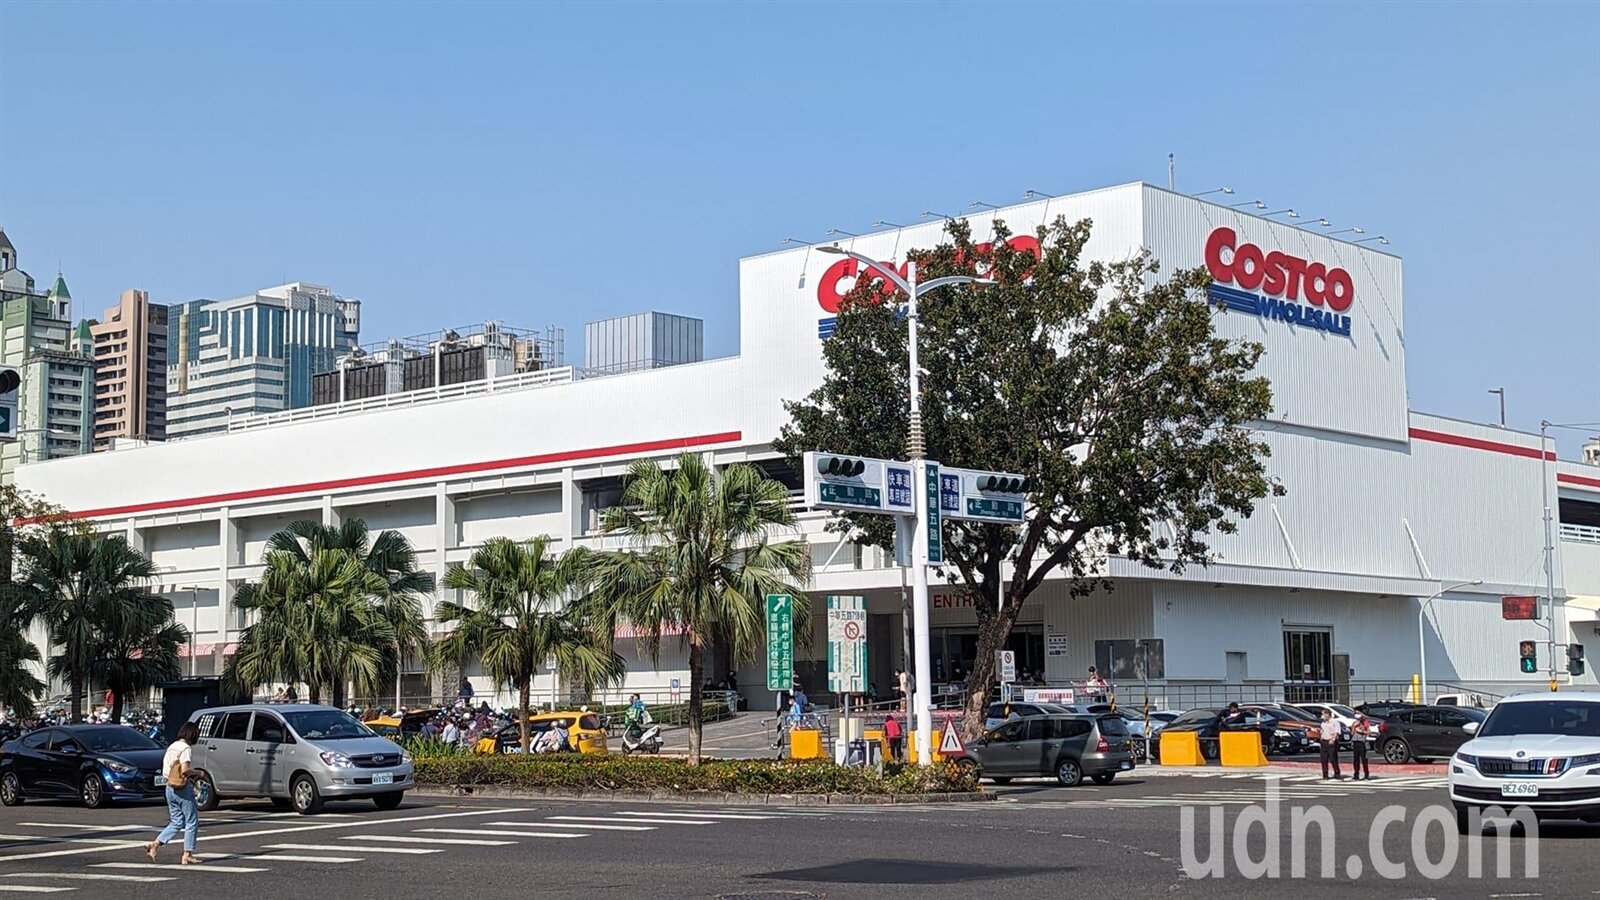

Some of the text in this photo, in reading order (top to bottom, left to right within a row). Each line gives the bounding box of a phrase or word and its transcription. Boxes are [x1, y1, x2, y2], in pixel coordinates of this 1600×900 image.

[1205, 227, 1354, 311] COSTCO
[1255, 296, 1351, 336] WHOLESALE
[888, 472, 910, 488] 快車道
[940, 477, 959, 493] 車道
[928, 481, 938, 541] 中華五路
[941, 493, 959, 509] 用號誌
